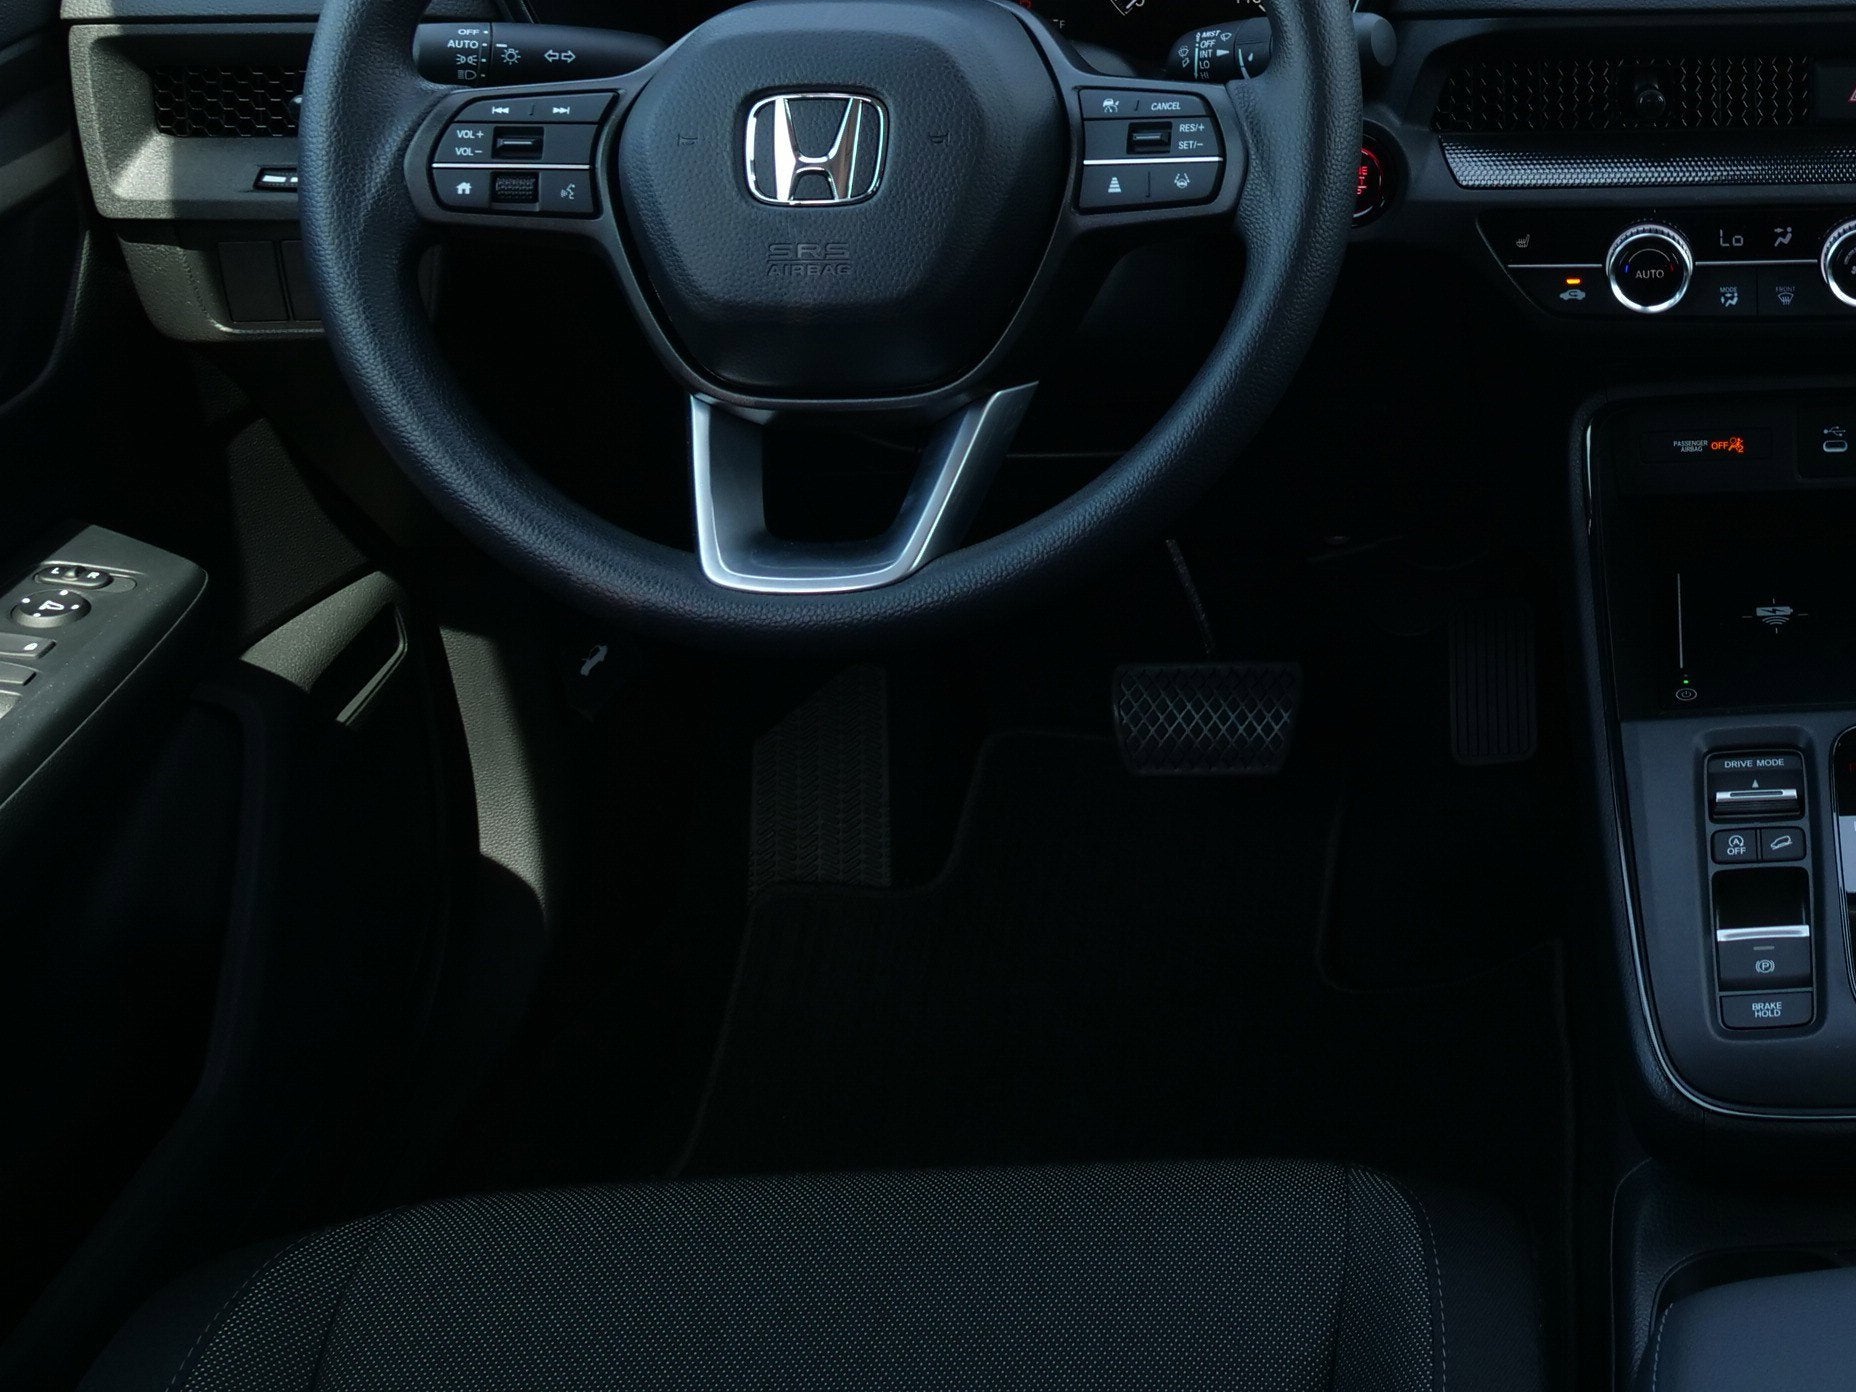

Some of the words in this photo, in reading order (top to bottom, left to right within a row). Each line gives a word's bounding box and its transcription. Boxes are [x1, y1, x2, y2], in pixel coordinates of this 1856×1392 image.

[458, 28, 480, 36] OFF
[447, 39, 479, 49] AUTO
[1200, 40, 1216, 49] OFF
[1199, 50, 1213, 58] INT
[1199, 60, 1210, 69] LO
[1151, 102, 1181, 111] CANCEL
[1719, 229, 1744, 247] Lo
[768, 242, 849, 259] SRS
[767, 263, 851, 276] AIRBAG
[1635, 269, 1664, 279] AUTO
[1711, 441, 1729, 450] OFF
[1724, 760, 1753, 769] DRIVE
[1756, 759, 1785, 767] MODE
[1727, 847, 1746, 855] OFF
[1752, 1002, 1782, 1010] BRAKE
[1754, 1009, 1781, 1018] HOLD
